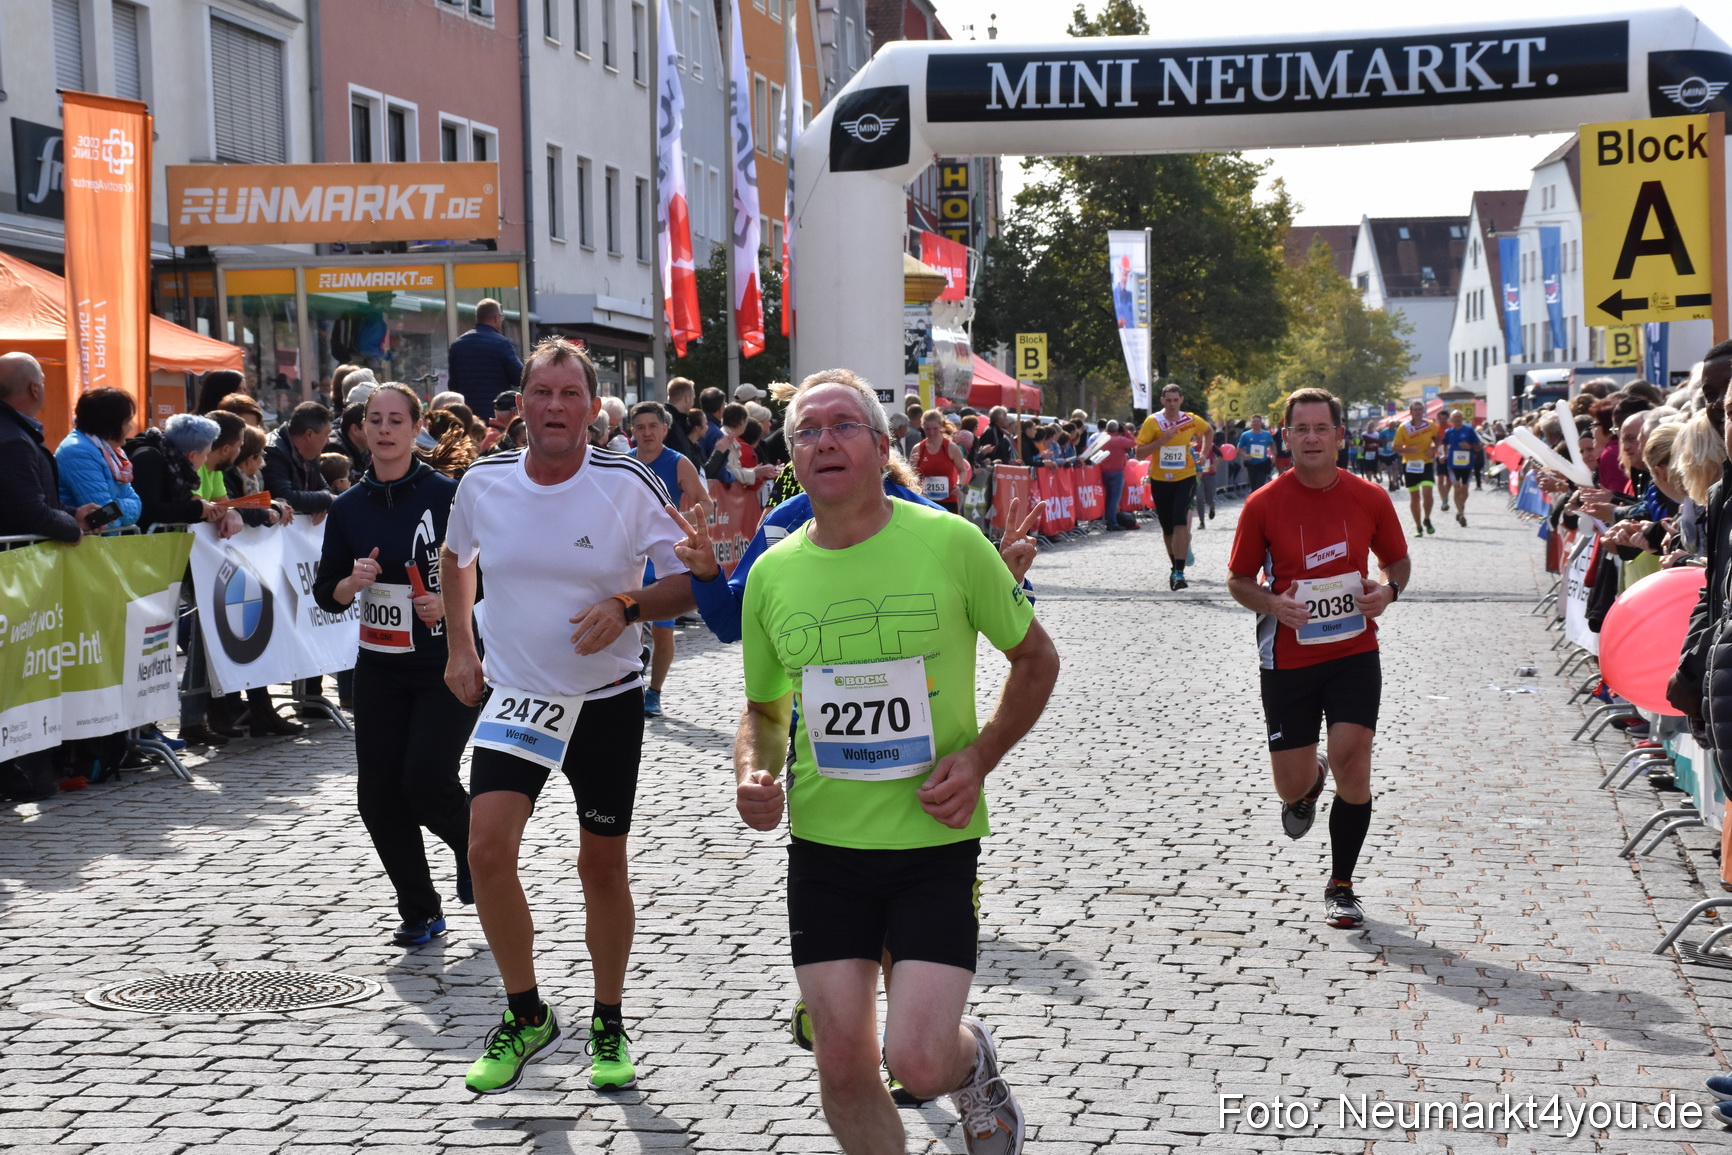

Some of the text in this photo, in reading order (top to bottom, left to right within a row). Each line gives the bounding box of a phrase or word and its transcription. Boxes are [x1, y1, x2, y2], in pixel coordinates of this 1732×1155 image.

[986, 37, 1559, 109] MINI NEUMARKT.
[1681, 87, 1706, 97] MINI
[859, 123, 879, 133] MINI
[1597, 124, 1708, 166] Block
[180, 184, 483, 225] RUNMARKT.DE
[1613, 180, 1696, 280] A
[319, 271, 433, 288] RUNMARKT.DE
[1019, 335, 1043, 344] Block
[1614, 333, 1632, 356] B
[1024, 348, 1040, 370] B
[1229, 399, 1239, 412] C
[1164, 452, 1183, 461] 2612
[926, 483, 945, 492] 2153
[573, 541, 594, 550] adidas
[1317, 549, 1336, 562] DEHN
[1305, 593, 1354, 619] 2038
[363, 603, 402, 627] 8009
[1322, 622, 1342, 632] Oliver
[844, 673, 888, 686] BOCK
[495, 697, 565, 733] 2472
[820, 697, 911, 736] 2270
[505, 728, 539, 746] Werner
[842, 746, 900, 763] Wolfgang
[594, 814, 616, 825] asics
